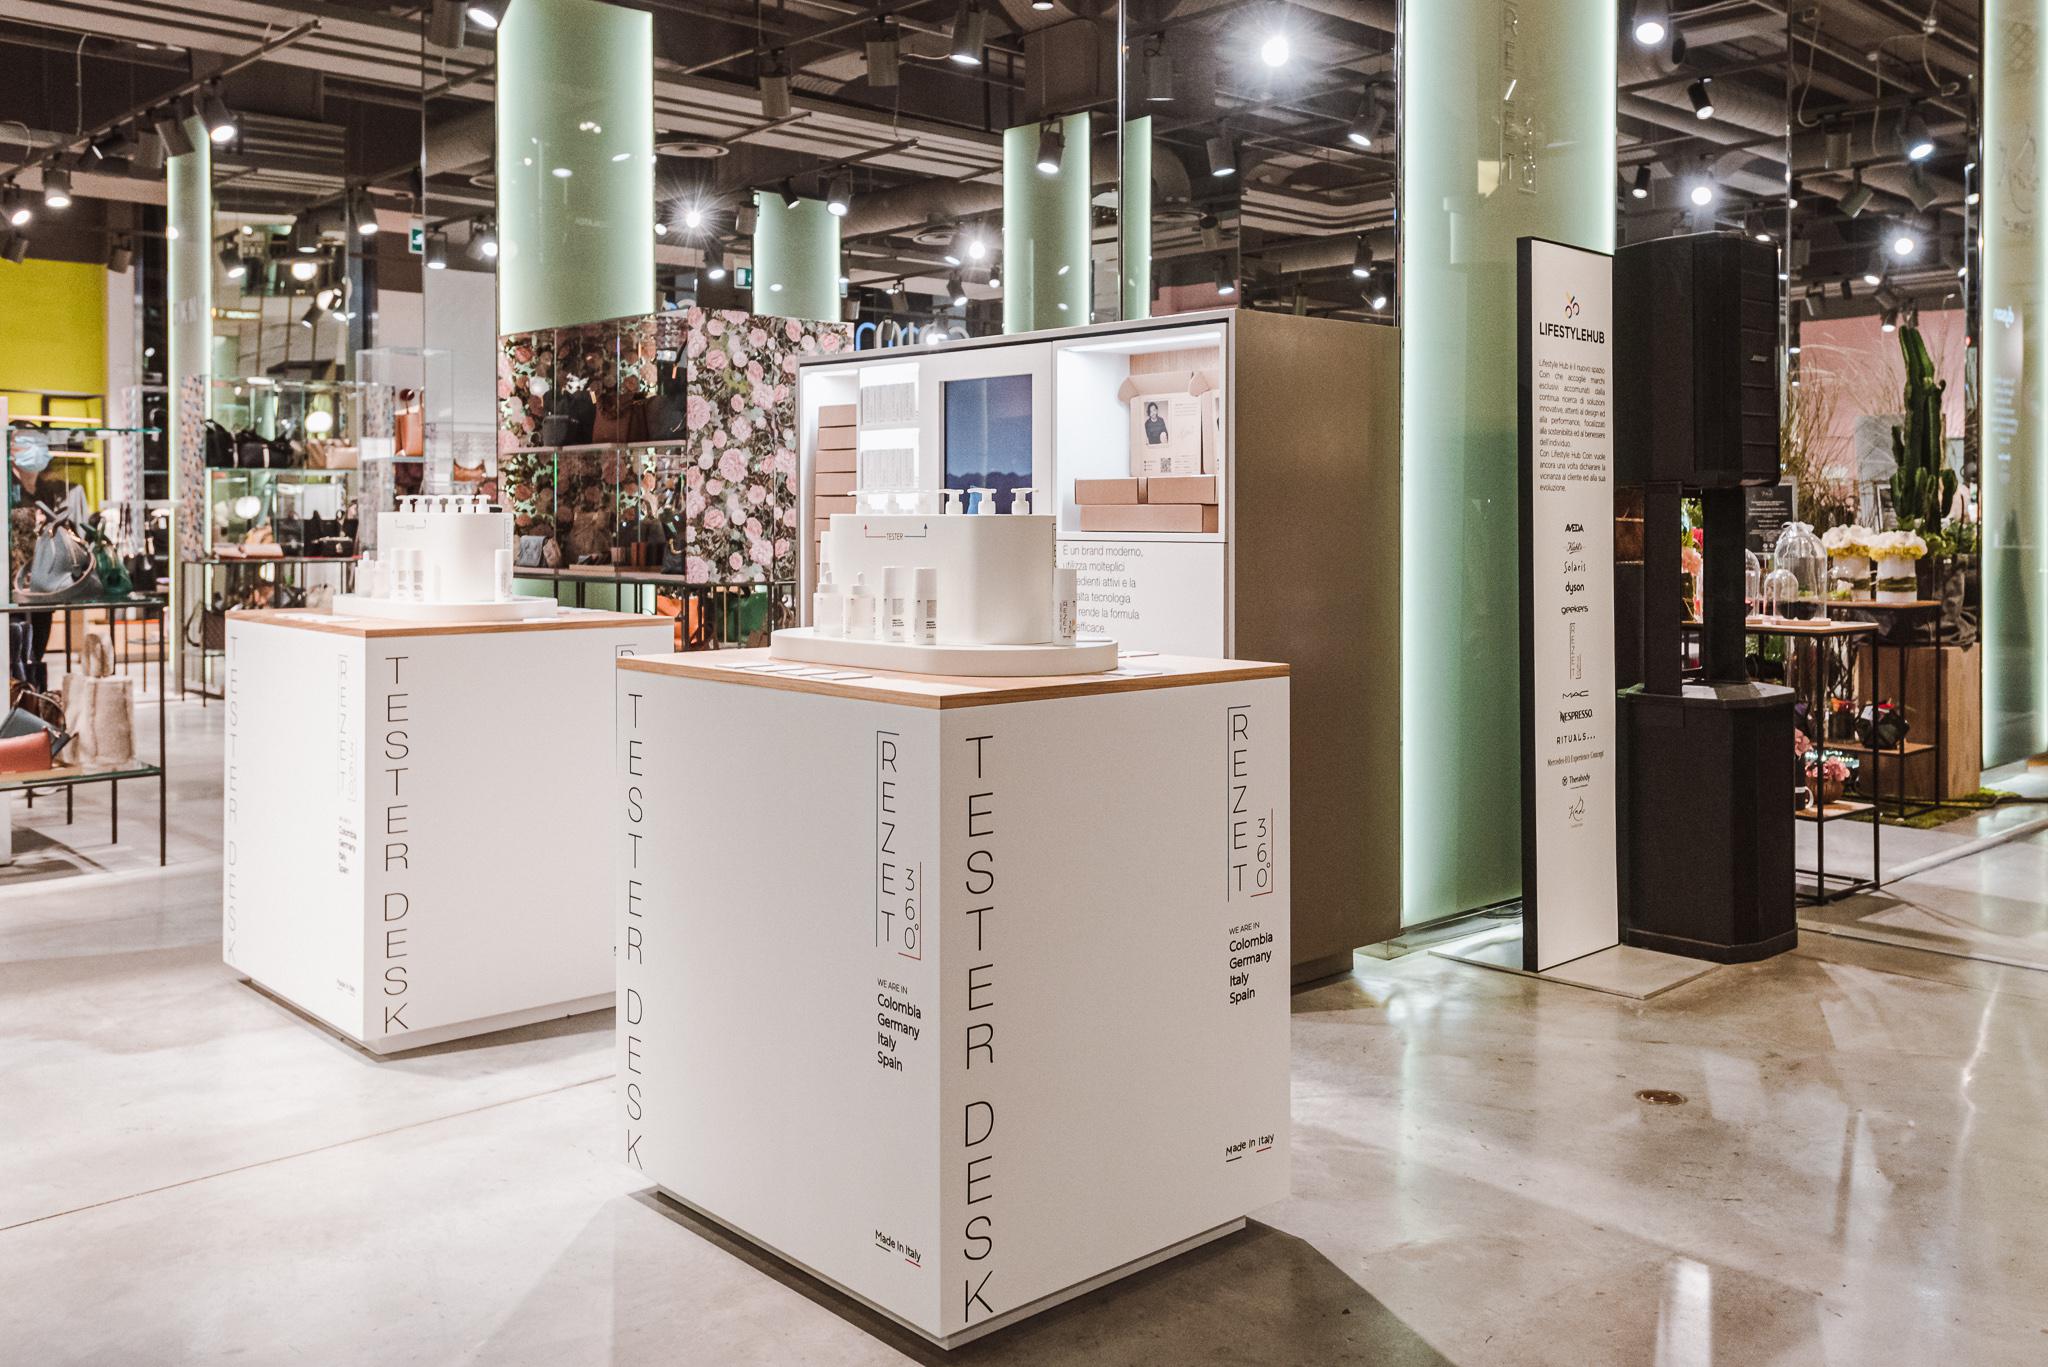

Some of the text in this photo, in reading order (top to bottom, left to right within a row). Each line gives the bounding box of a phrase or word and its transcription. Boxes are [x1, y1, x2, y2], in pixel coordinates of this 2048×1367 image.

[1539, 322, 1605, 344] LIFESTYLEHUB
[886, 532, 904, 541] TESTER
[1565, 523, 1584, 533] AVEDA
[1070, 547, 1080, 556] un
[1082, 545, 1104, 556] brand
[1105, 546, 1144, 558] moderno,
[1089, 562, 1125, 573] molteplici
[1563, 561, 1586, 574] Solaris
[1102, 578, 1120, 587] attivi
[1129, 578, 1136, 588] la
[1565, 580, 1585, 595] dyson
[1091, 593, 1131, 605] tecnologia
[1078, 607, 1140, 620] rende la formula
[1560, 709, 1593, 723] NESPRESSO
[228, 636, 239, 962] TESTER DESK
[1232, 713, 1249, 892] REZET
[383, 656, 409, 1034] TESTER DESK
[881, 741, 897, 942] REZET
[626, 694, 644, 1170] TESTER DESK
[1228, 921, 1260, 936] WE ARE IN
[1229, 932, 1273, 953] Colombia
[1229, 950, 1272, 969] Germany
[877, 978, 908, 995] WE ARE IN
[1229, 971, 1250, 987] Italy
[1229, 987, 1256, 1006] Spain
[877, 993, 921, 1020] Colombia
[877, 1012, 920, 1041] Germany
[964, 735, 995, 1323] TESTER DESK
[877, 1031, 897, 1052] Italy
[877, 1050, 903, 1072] Spain
[1225, 1141, 1247, 1157] Made
[1258, 1133, 1275, 1146] Italy
[875, 1229, 896, 1249] Made
[905, 1244, 921, 1263] Italy
